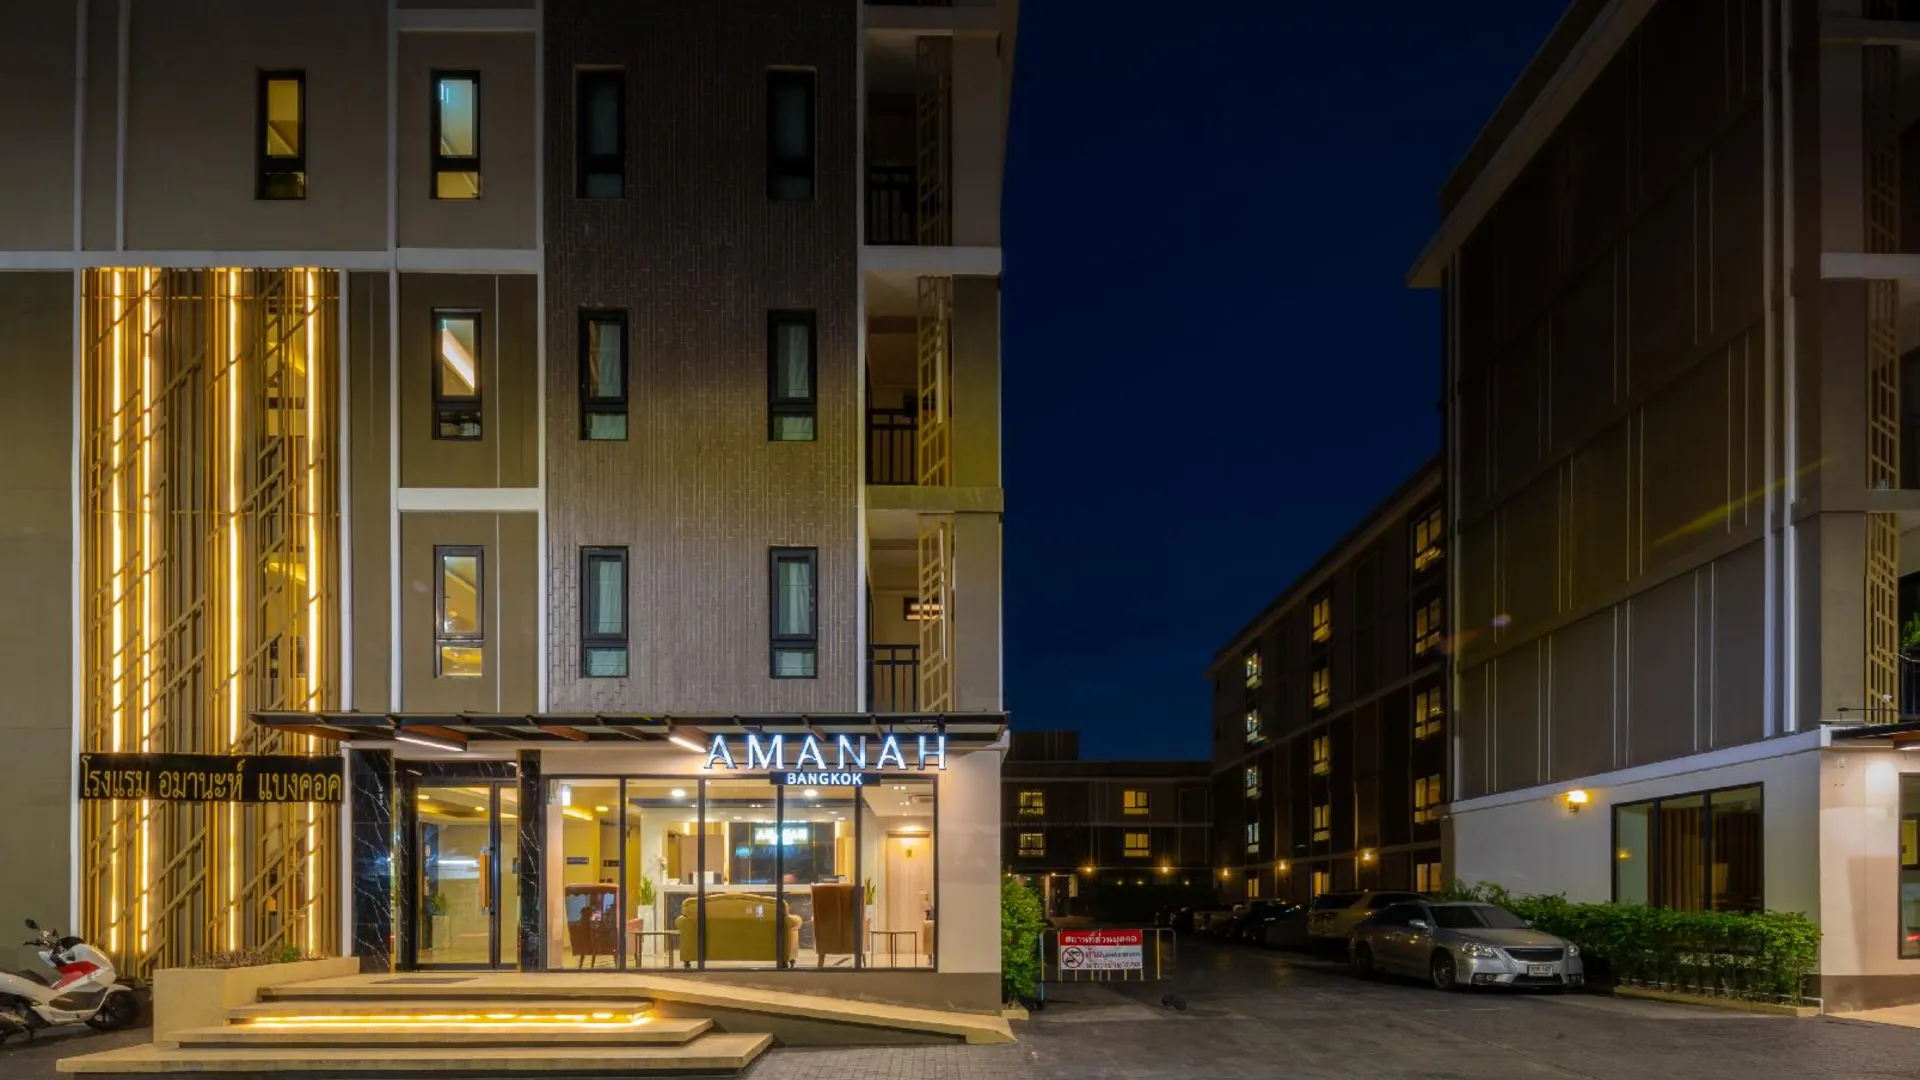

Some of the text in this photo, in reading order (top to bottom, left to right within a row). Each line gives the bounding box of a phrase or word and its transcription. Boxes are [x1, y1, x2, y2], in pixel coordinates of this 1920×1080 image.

[704, 734, 946, 770] AMANAH
[81, 754, 150, 797] โรงแรม
[159, 759, 246, 800] อมานะห์
[787, 772, 863, 785] BANGKOK
